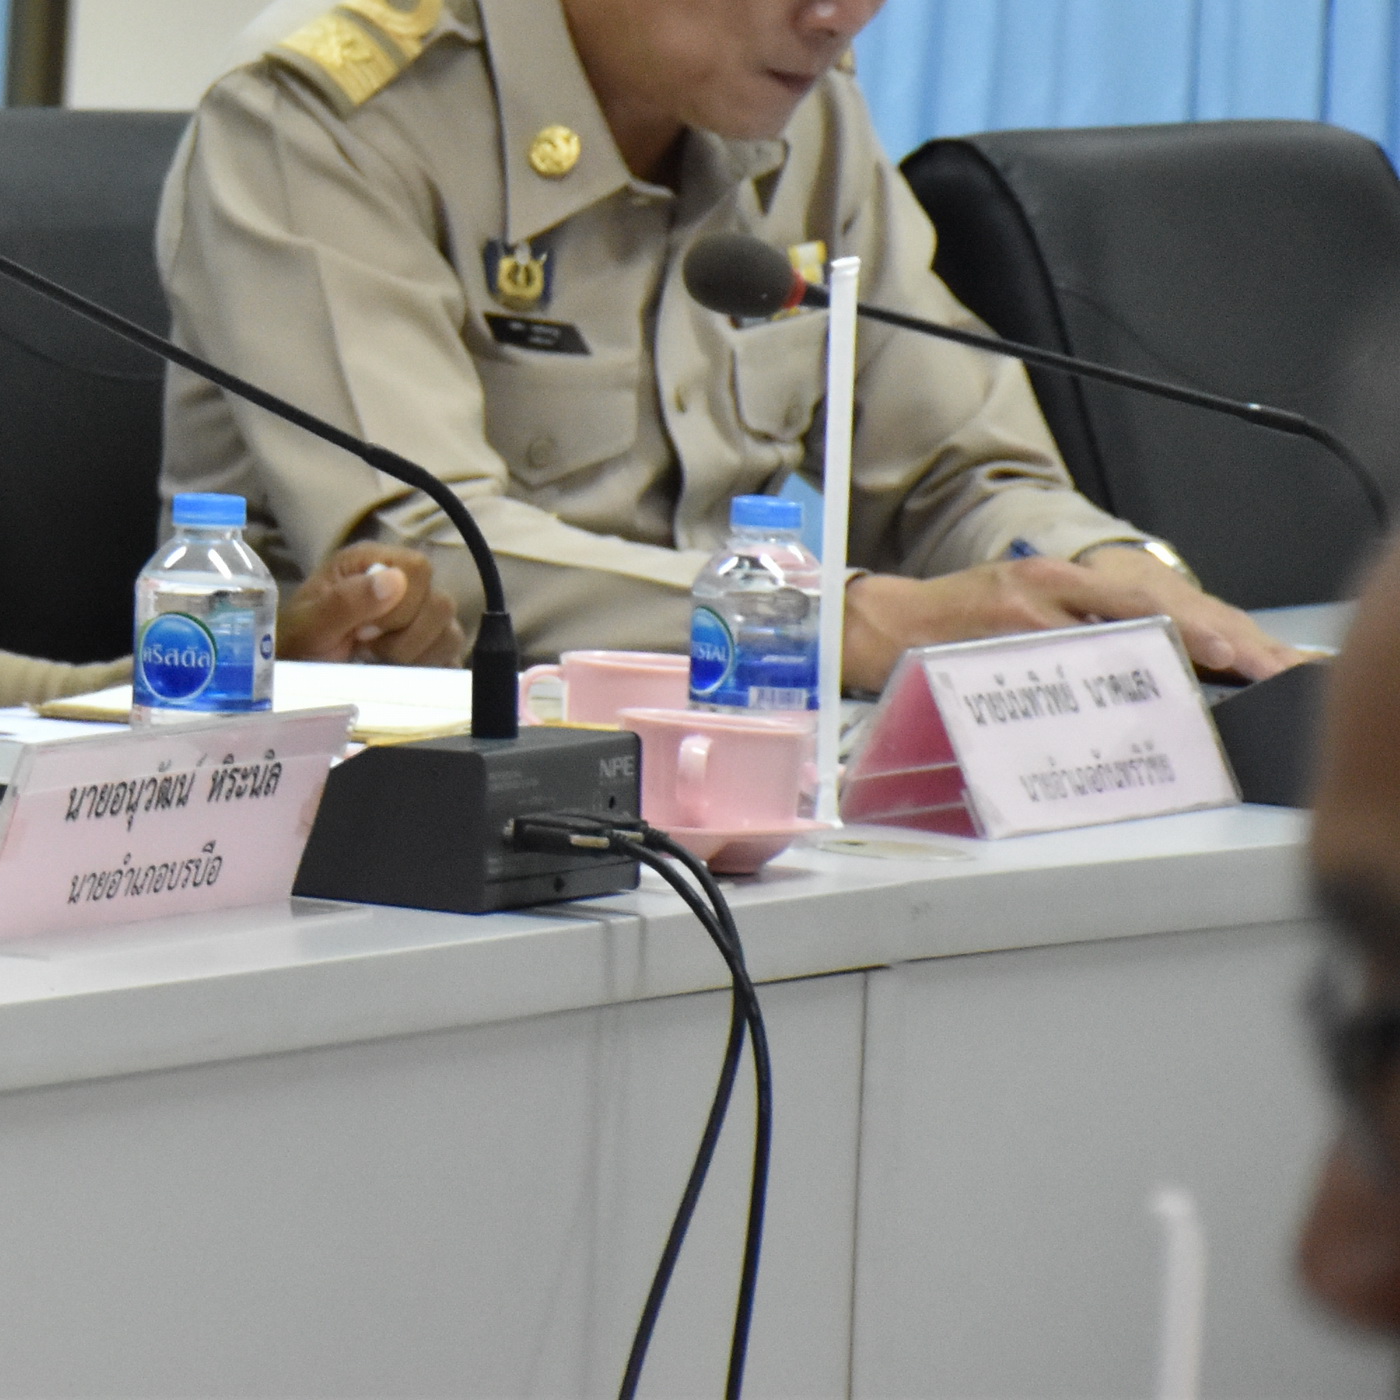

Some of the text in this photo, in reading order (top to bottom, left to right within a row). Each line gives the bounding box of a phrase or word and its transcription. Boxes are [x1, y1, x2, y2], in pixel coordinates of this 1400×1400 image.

[67, 839, 223, 904] นายอำเภอบรบือ
